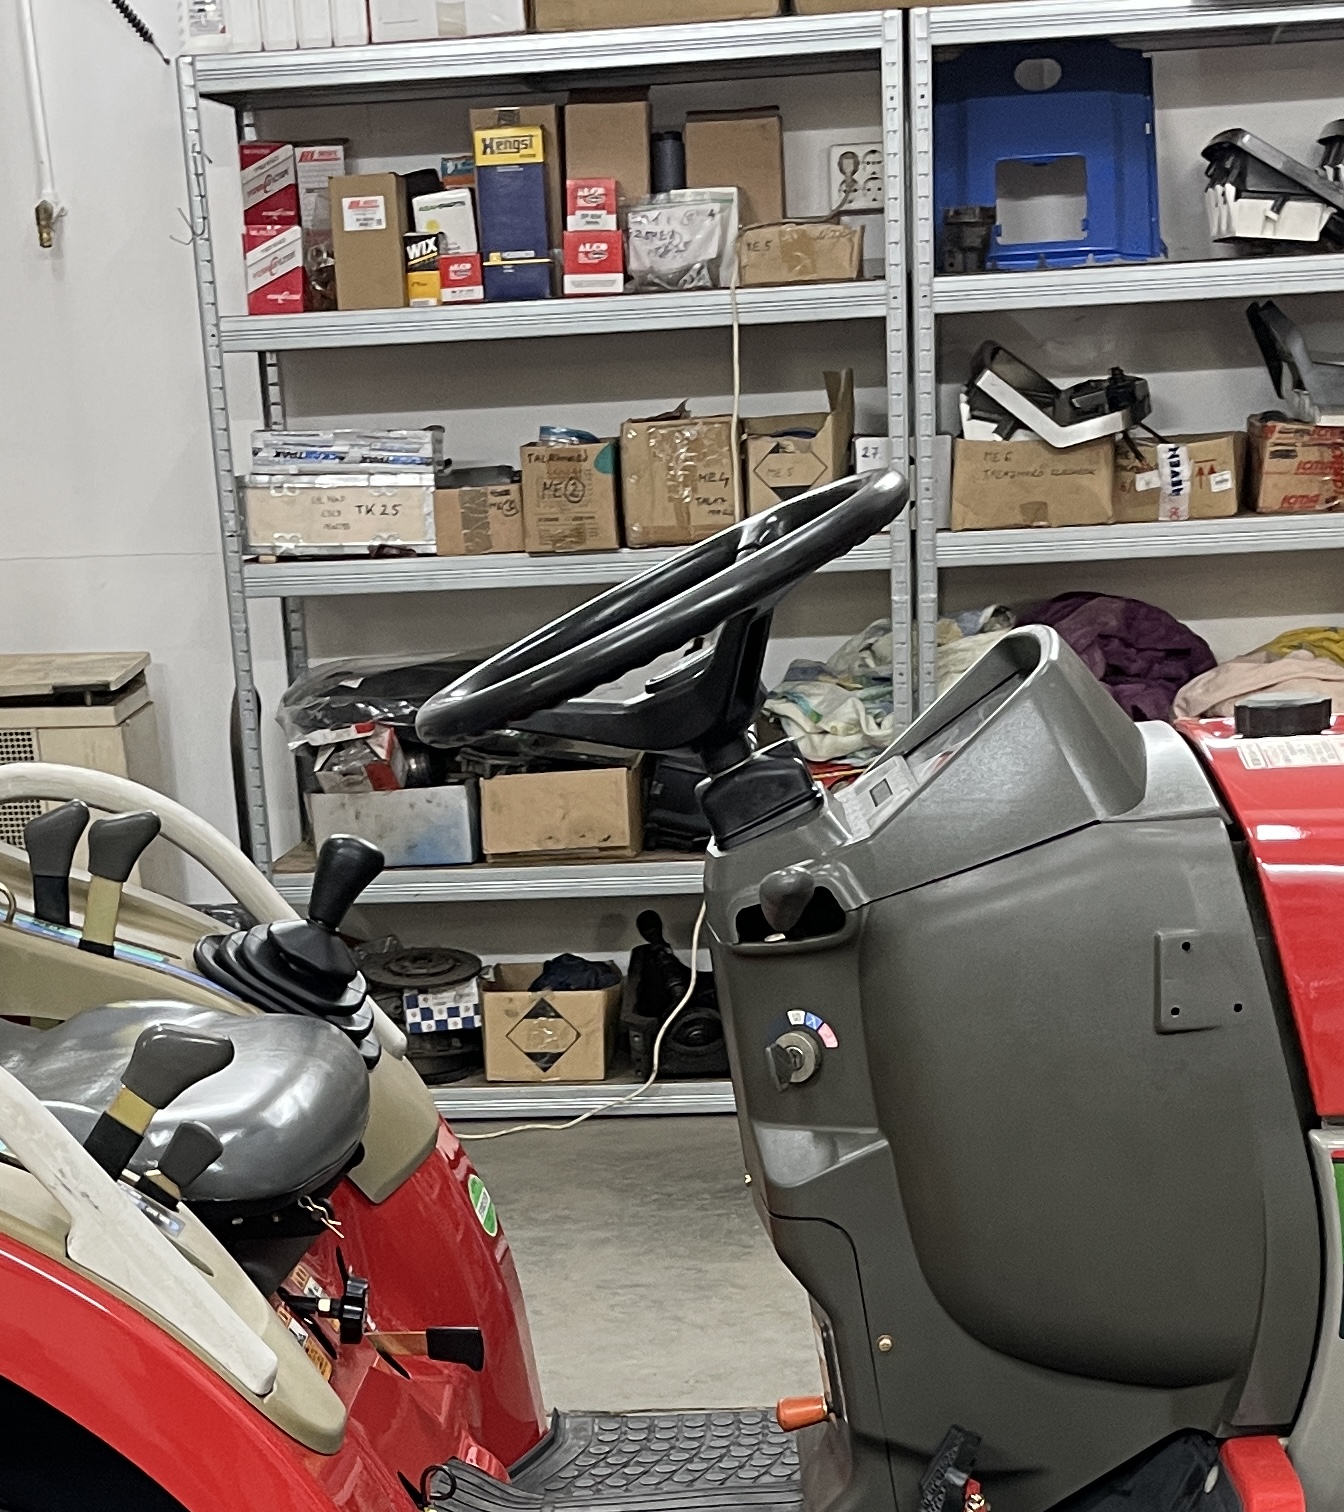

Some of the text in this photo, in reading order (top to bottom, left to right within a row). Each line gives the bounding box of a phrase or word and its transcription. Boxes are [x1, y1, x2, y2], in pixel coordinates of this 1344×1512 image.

[481, 134, 534, 155] Hengst
[406, 235, 438, 261] WIX
[354, 503, 403, 517] TK 25
